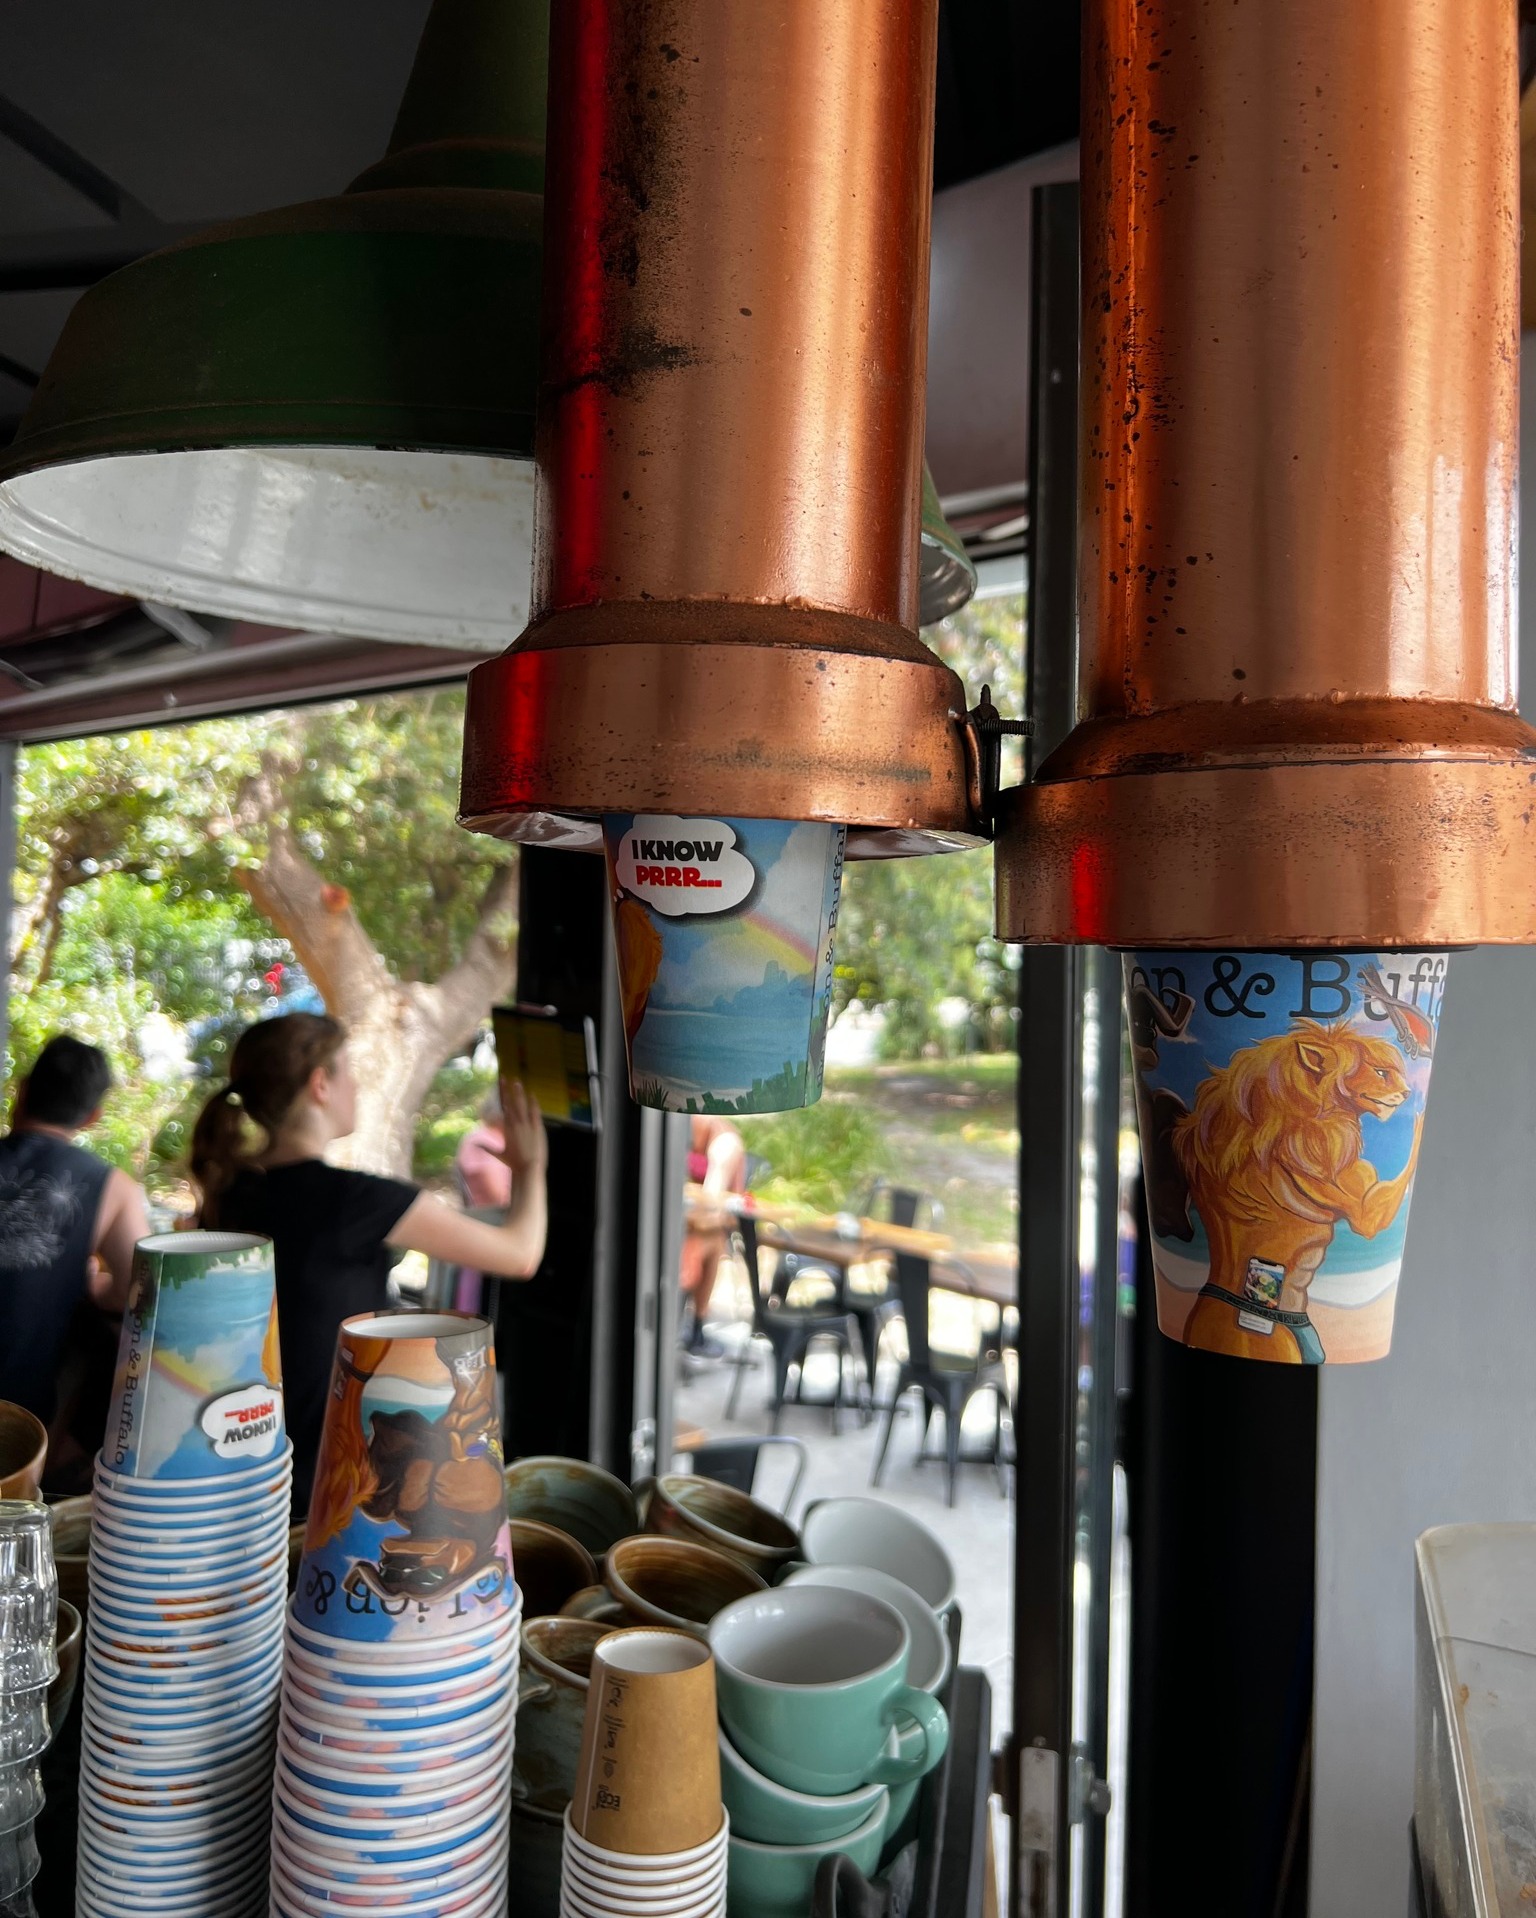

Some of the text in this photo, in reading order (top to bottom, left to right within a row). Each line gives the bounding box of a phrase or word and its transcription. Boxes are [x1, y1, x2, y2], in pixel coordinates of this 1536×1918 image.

[631, 839, 724, 862] I KNOW
[1204, 954, 1275, 1019] &
[1289, 954, 1446, 1022] Buff
[127, 1348, 142, 1370] &
[114, 1373, 139, 1466] Buffalo
[223, 1418, 272, 1444] KNOW
[306, 1565, 336, 1615] &
